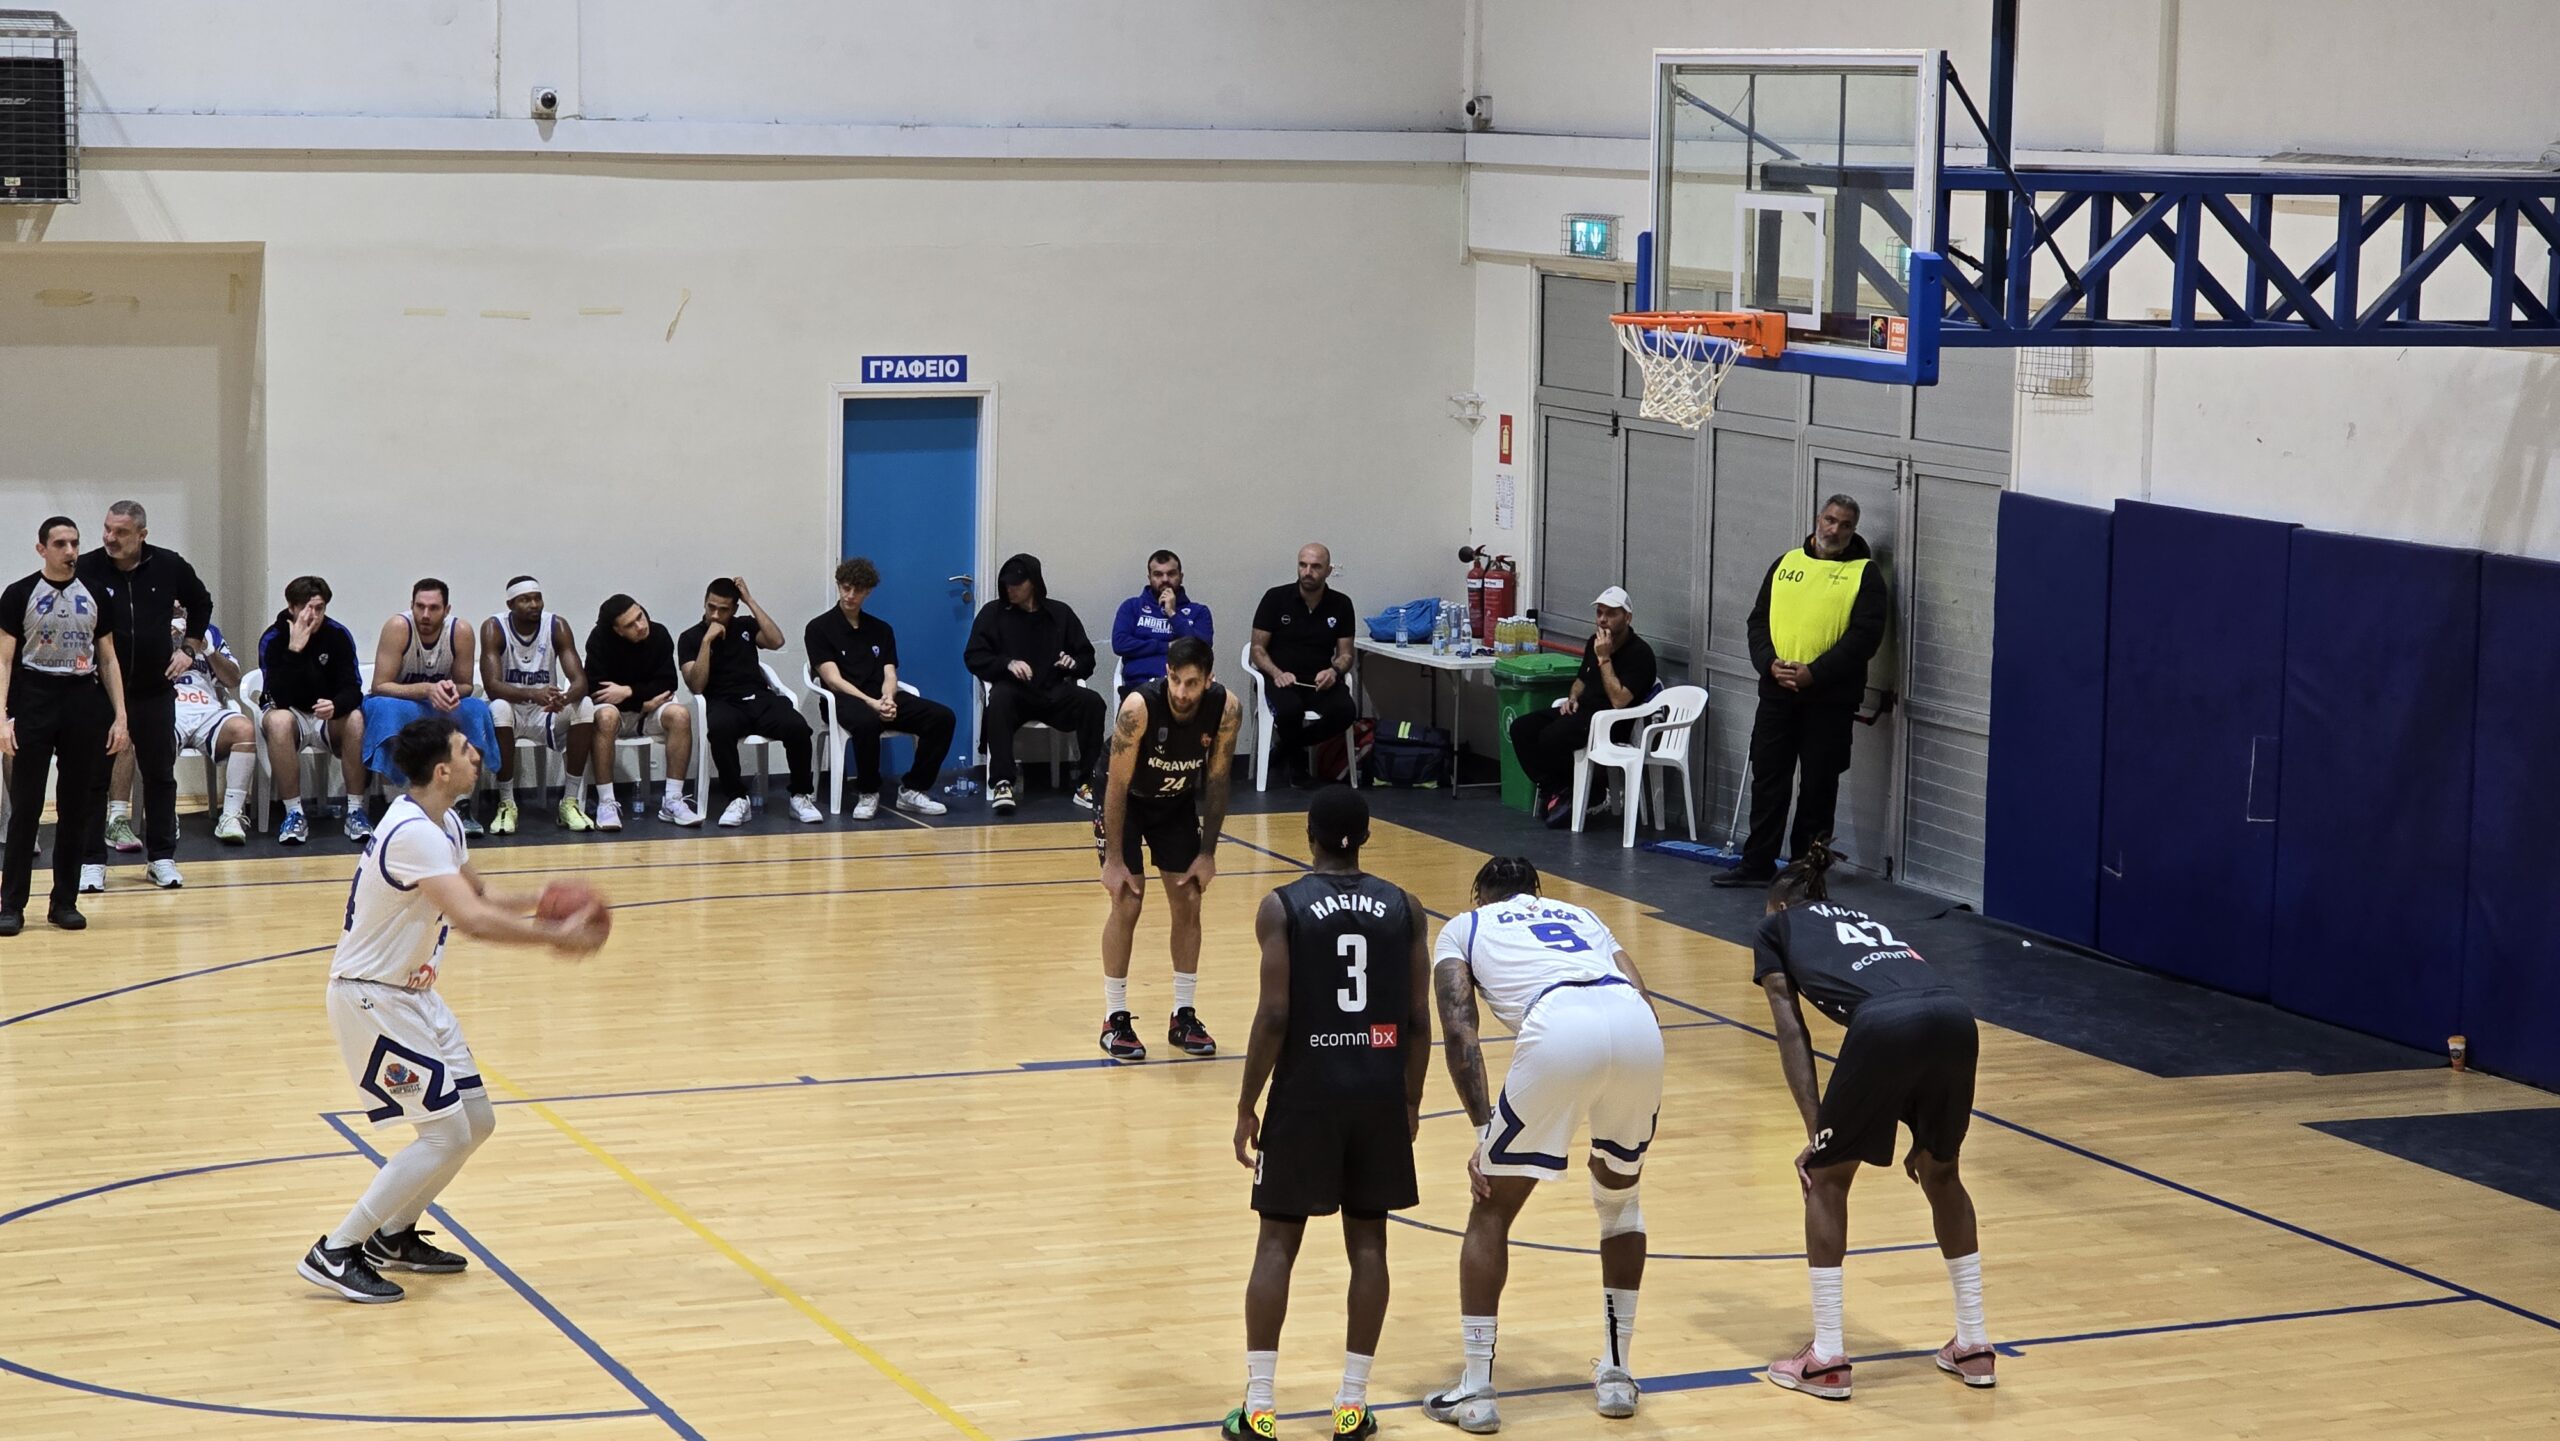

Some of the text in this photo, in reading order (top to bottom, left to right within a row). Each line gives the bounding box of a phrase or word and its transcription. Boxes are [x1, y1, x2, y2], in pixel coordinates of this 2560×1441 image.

[869, 359, 960, 379] ΓΡΑΦΕΙΟ
[1778, 568, 1804, 583] 040
[1160, 776, 1187, 791] 24
[1310, 893, 1387, 920] HAGINS
[1835, 920, 1910, 947] 42
[1851, 948, 1924, 972] ecomm
[1337, 933, 1368, 1012] 3
[1310, 1026, 1394, 1047] ecommbx
